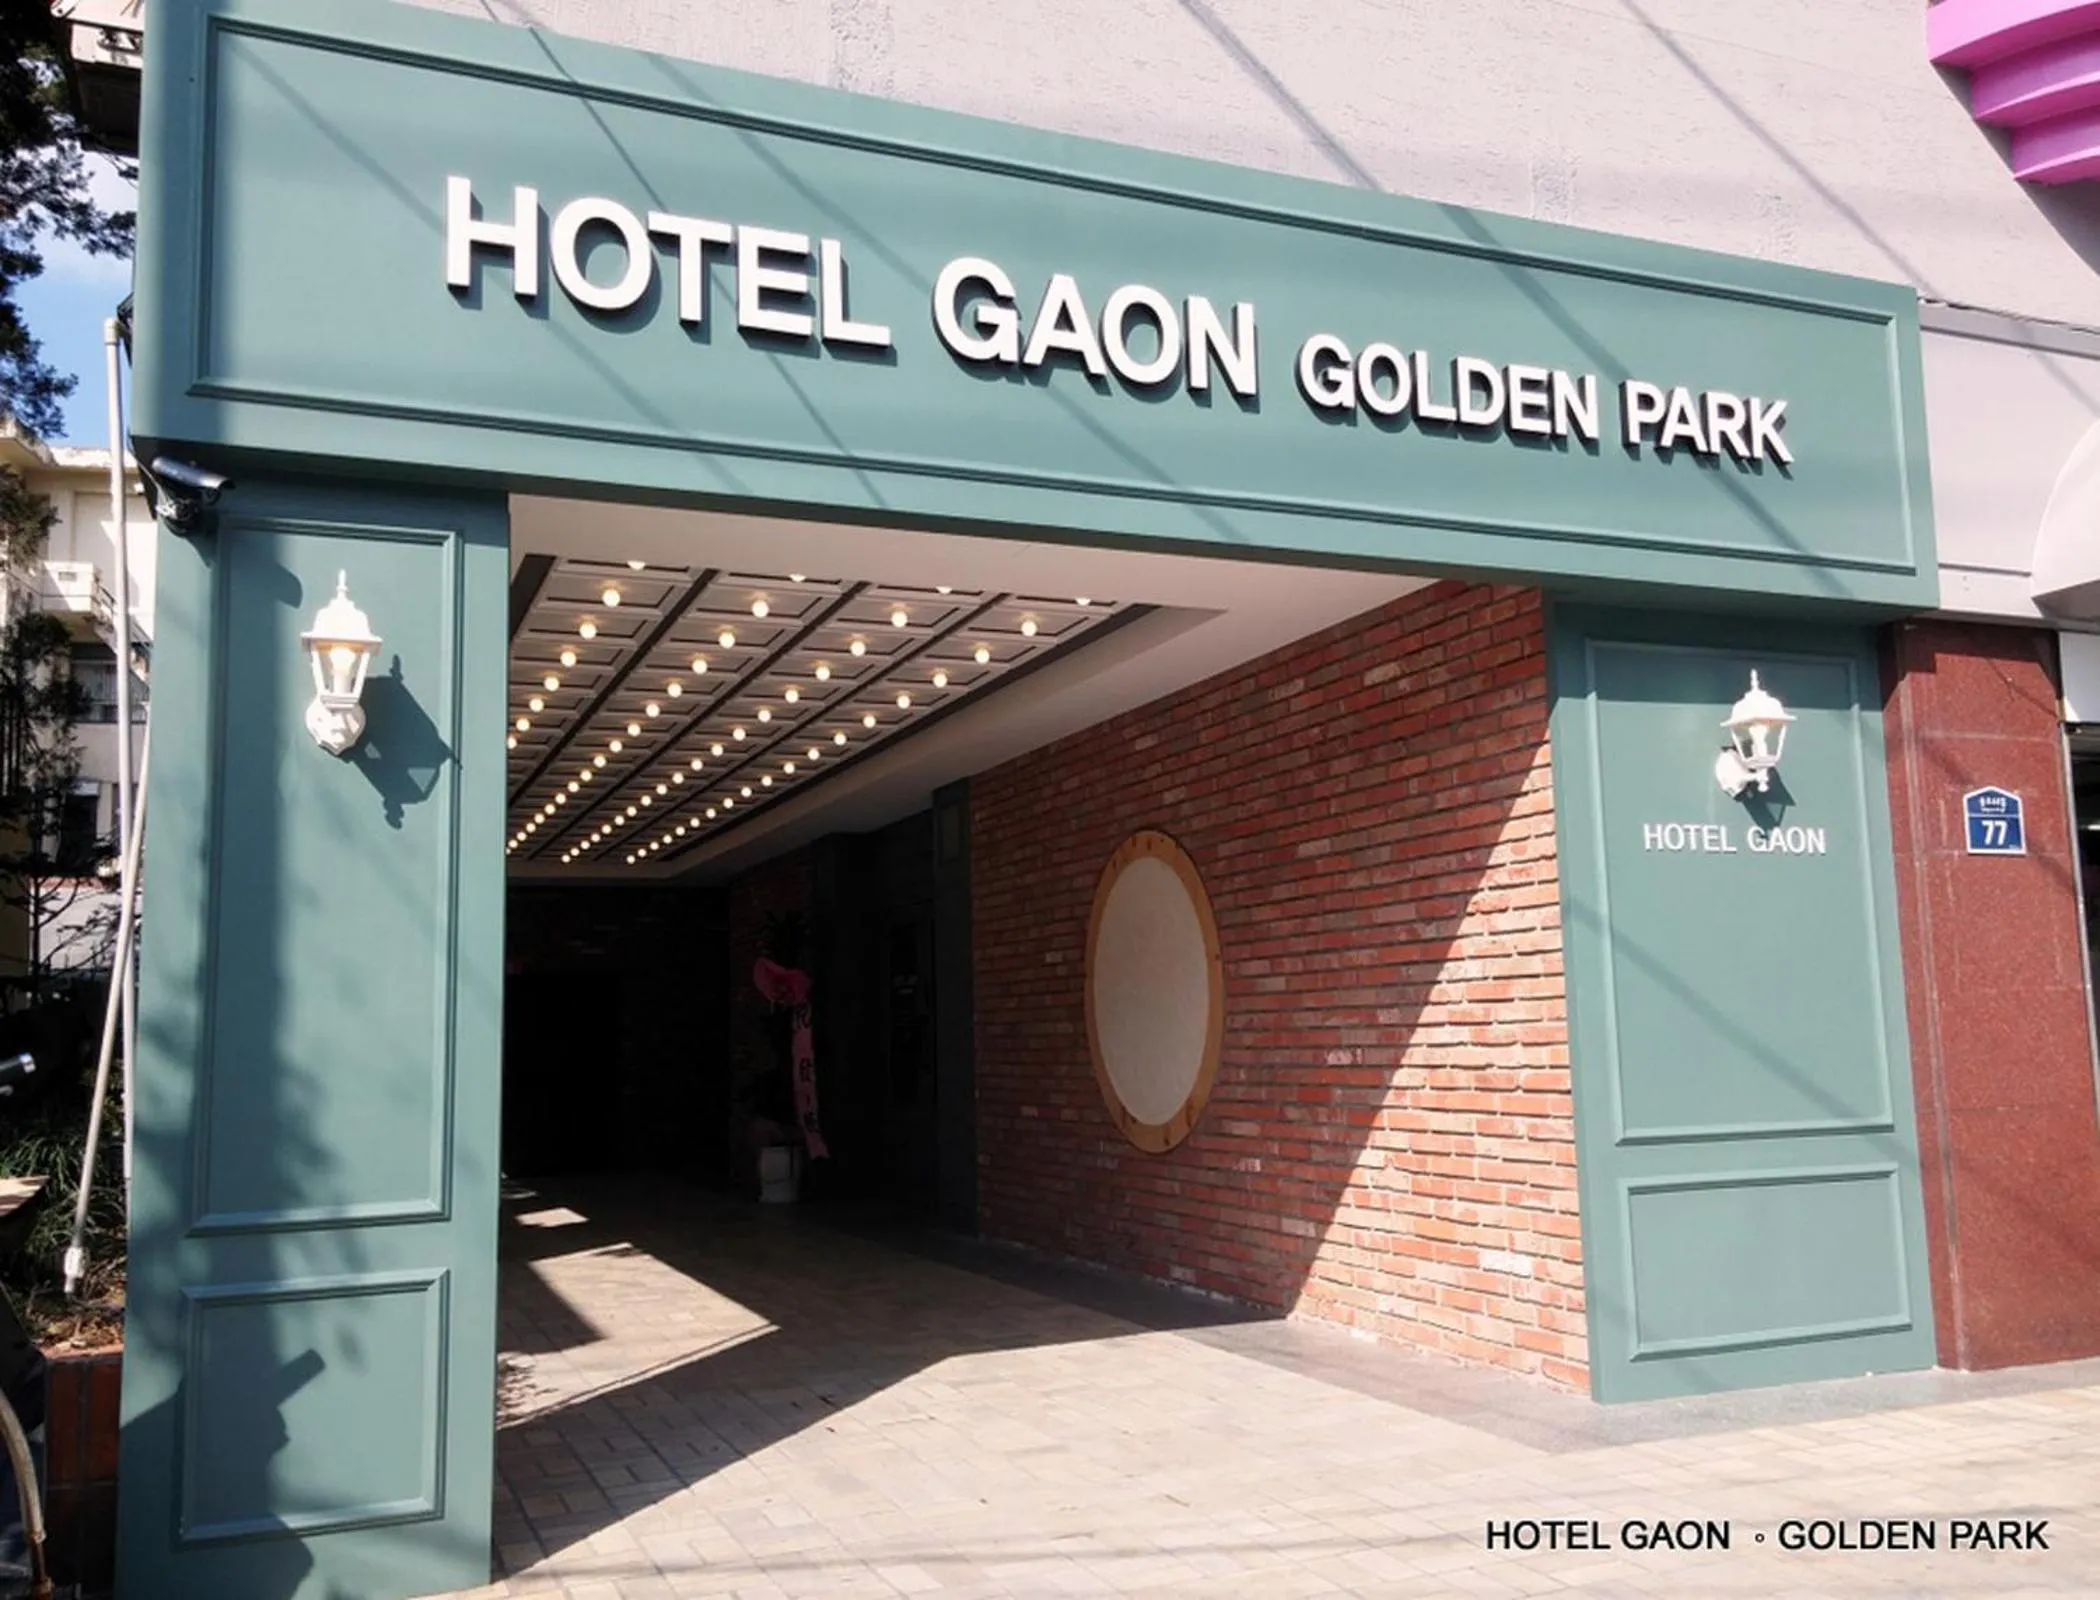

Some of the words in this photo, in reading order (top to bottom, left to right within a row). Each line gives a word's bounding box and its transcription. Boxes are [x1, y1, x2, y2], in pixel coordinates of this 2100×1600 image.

[444, 175, 892, 347] HOTEL
[933, 256, 1257, 396] GAON
[1299, 333, 1600, 440] GOLDEN
[1624, 379, 1795, 464] PARK
[1643, 823, 1738, 852] HOTEL
[1746, 825, 1827, 854] GAON
[1981, 819, 2008, 846] 77
